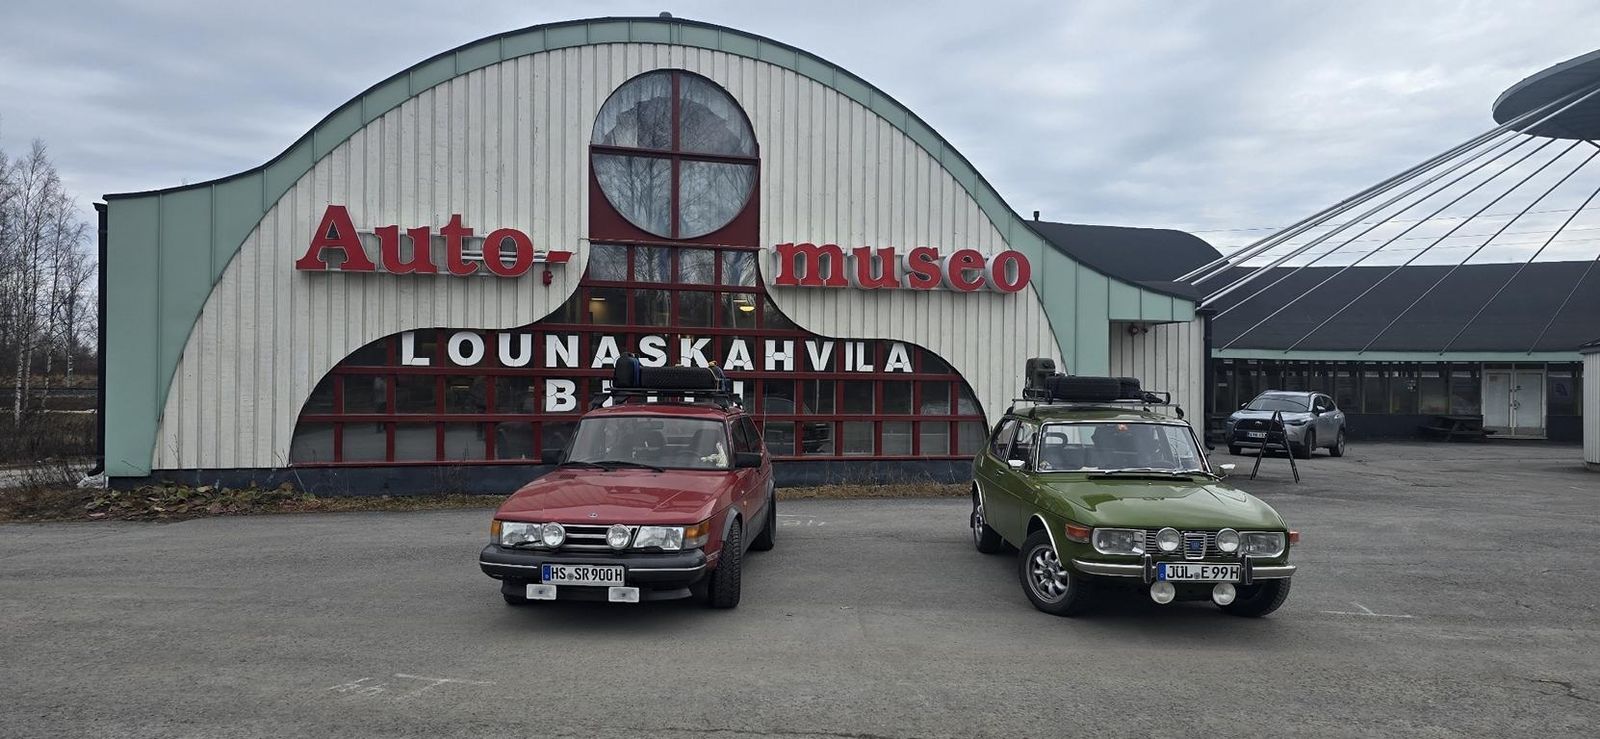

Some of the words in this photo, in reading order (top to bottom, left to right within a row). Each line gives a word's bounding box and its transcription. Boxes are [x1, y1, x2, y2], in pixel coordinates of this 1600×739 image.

[296, 204, 572, 277] Auto-
[774, 242, 1032, 293] museo
[401, 331, 913, 373] LOUNASKAHVILA
[551, 567, 566, 580] HS
[1167, 566, 1193, 578] JÜL
